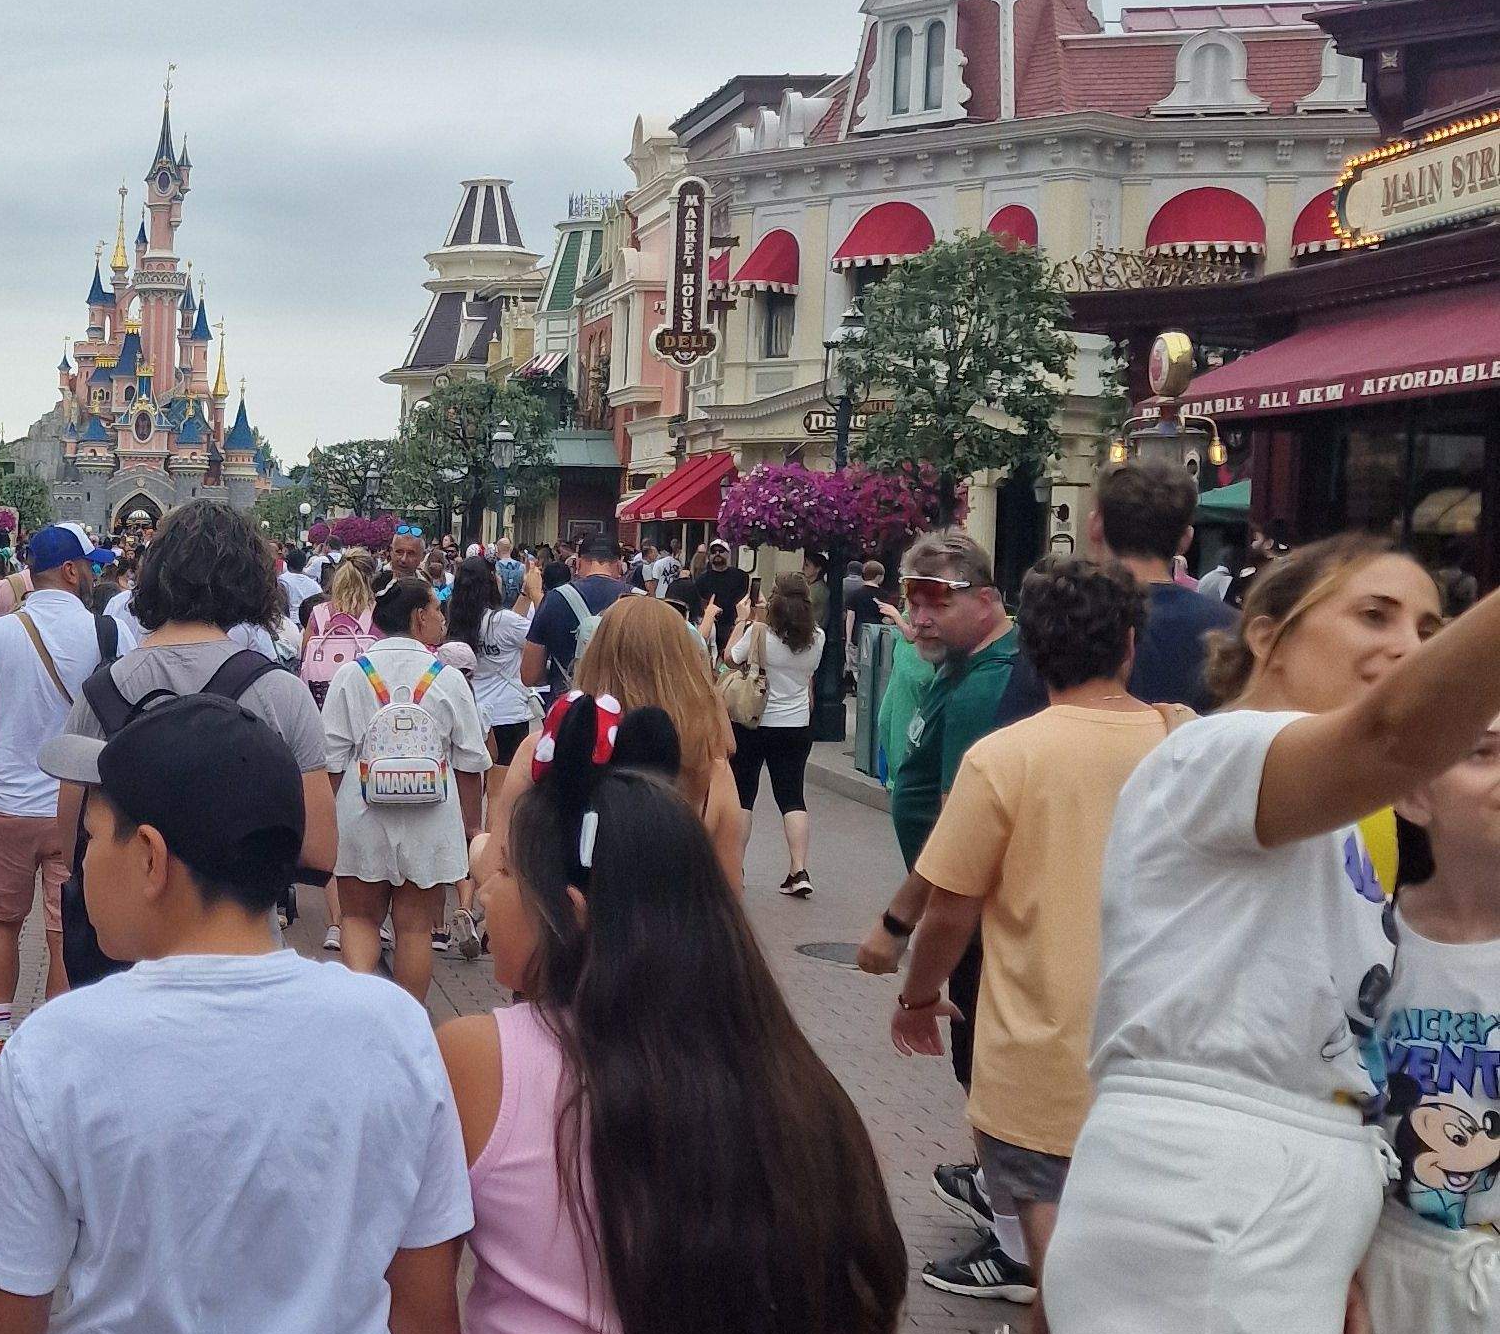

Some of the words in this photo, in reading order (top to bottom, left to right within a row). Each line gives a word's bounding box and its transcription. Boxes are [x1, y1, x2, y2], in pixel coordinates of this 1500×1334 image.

[1381, 160, 1442, 216] MAIN
[1452, 146, 1500, 197] STR
[682, 194, 700, 267] MARKET
[681, 273, 695, 333] HOUSE
[664, 335, 709, 348] DELI
[1258, 391, 1291, 409] ALL
[1297, 383, 1346, 406] NEW
[1360, 360, 1500, 396] AFFORDABLE
[376, 771, 436, 794] MARVEL
